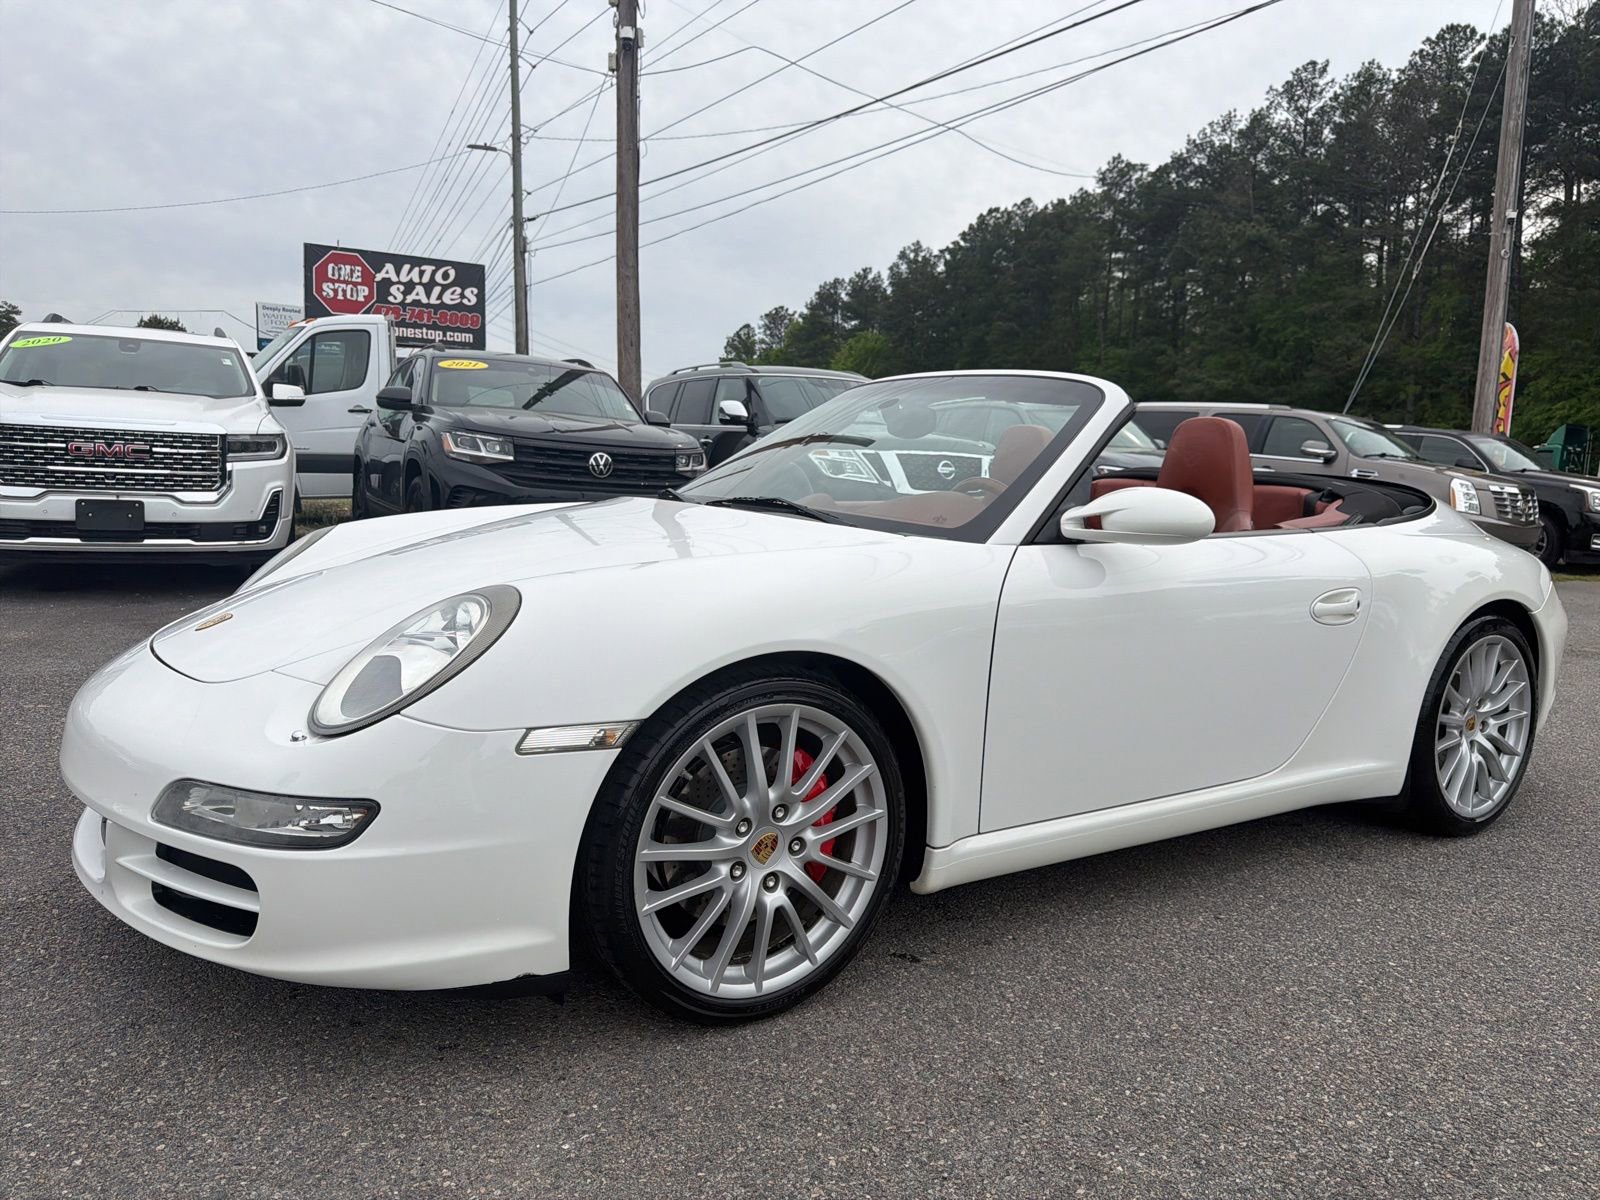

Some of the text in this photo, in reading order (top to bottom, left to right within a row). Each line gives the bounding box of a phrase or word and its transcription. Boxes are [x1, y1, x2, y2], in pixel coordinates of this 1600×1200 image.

[327, 263, 362, 283] ONE
[374, 262, 456, 285] AUTO
[322, 282, 369, 302] STOP
[262, 305, 281, 313] Deeply
[22, 337, 62, 346] 2020
[68, 441, 150, 459] GMC
